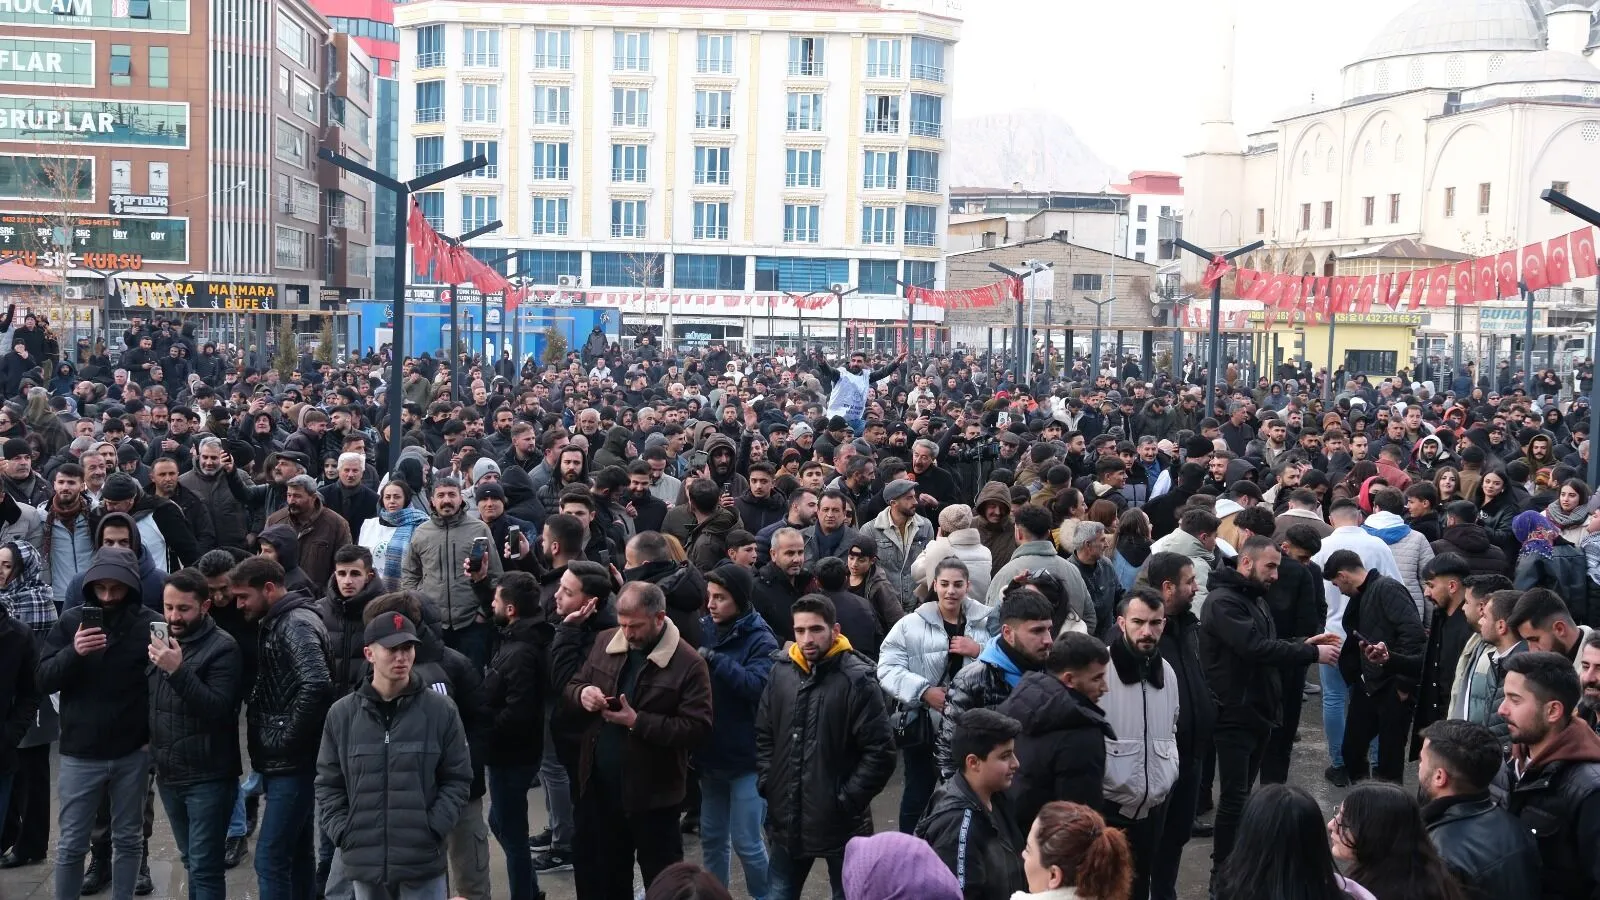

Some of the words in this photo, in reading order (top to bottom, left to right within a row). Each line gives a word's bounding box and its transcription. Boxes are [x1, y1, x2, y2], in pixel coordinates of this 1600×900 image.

[38, 228, 52, 236] SRC
[76, 229, 90, 237] SRC
[80, 238, 86, 246] 4
[83, 252, 143, 270] KURSU
[209, 283, 275, 298] MARMARA
[136, 295, 175, 307] BFE
[224, 296, 258, 310] BÜFE
[1366, 313, 1381, 322] 432
[1383, 314, 1398, 323] 216
[1411, 315, 1422, 324] 21
